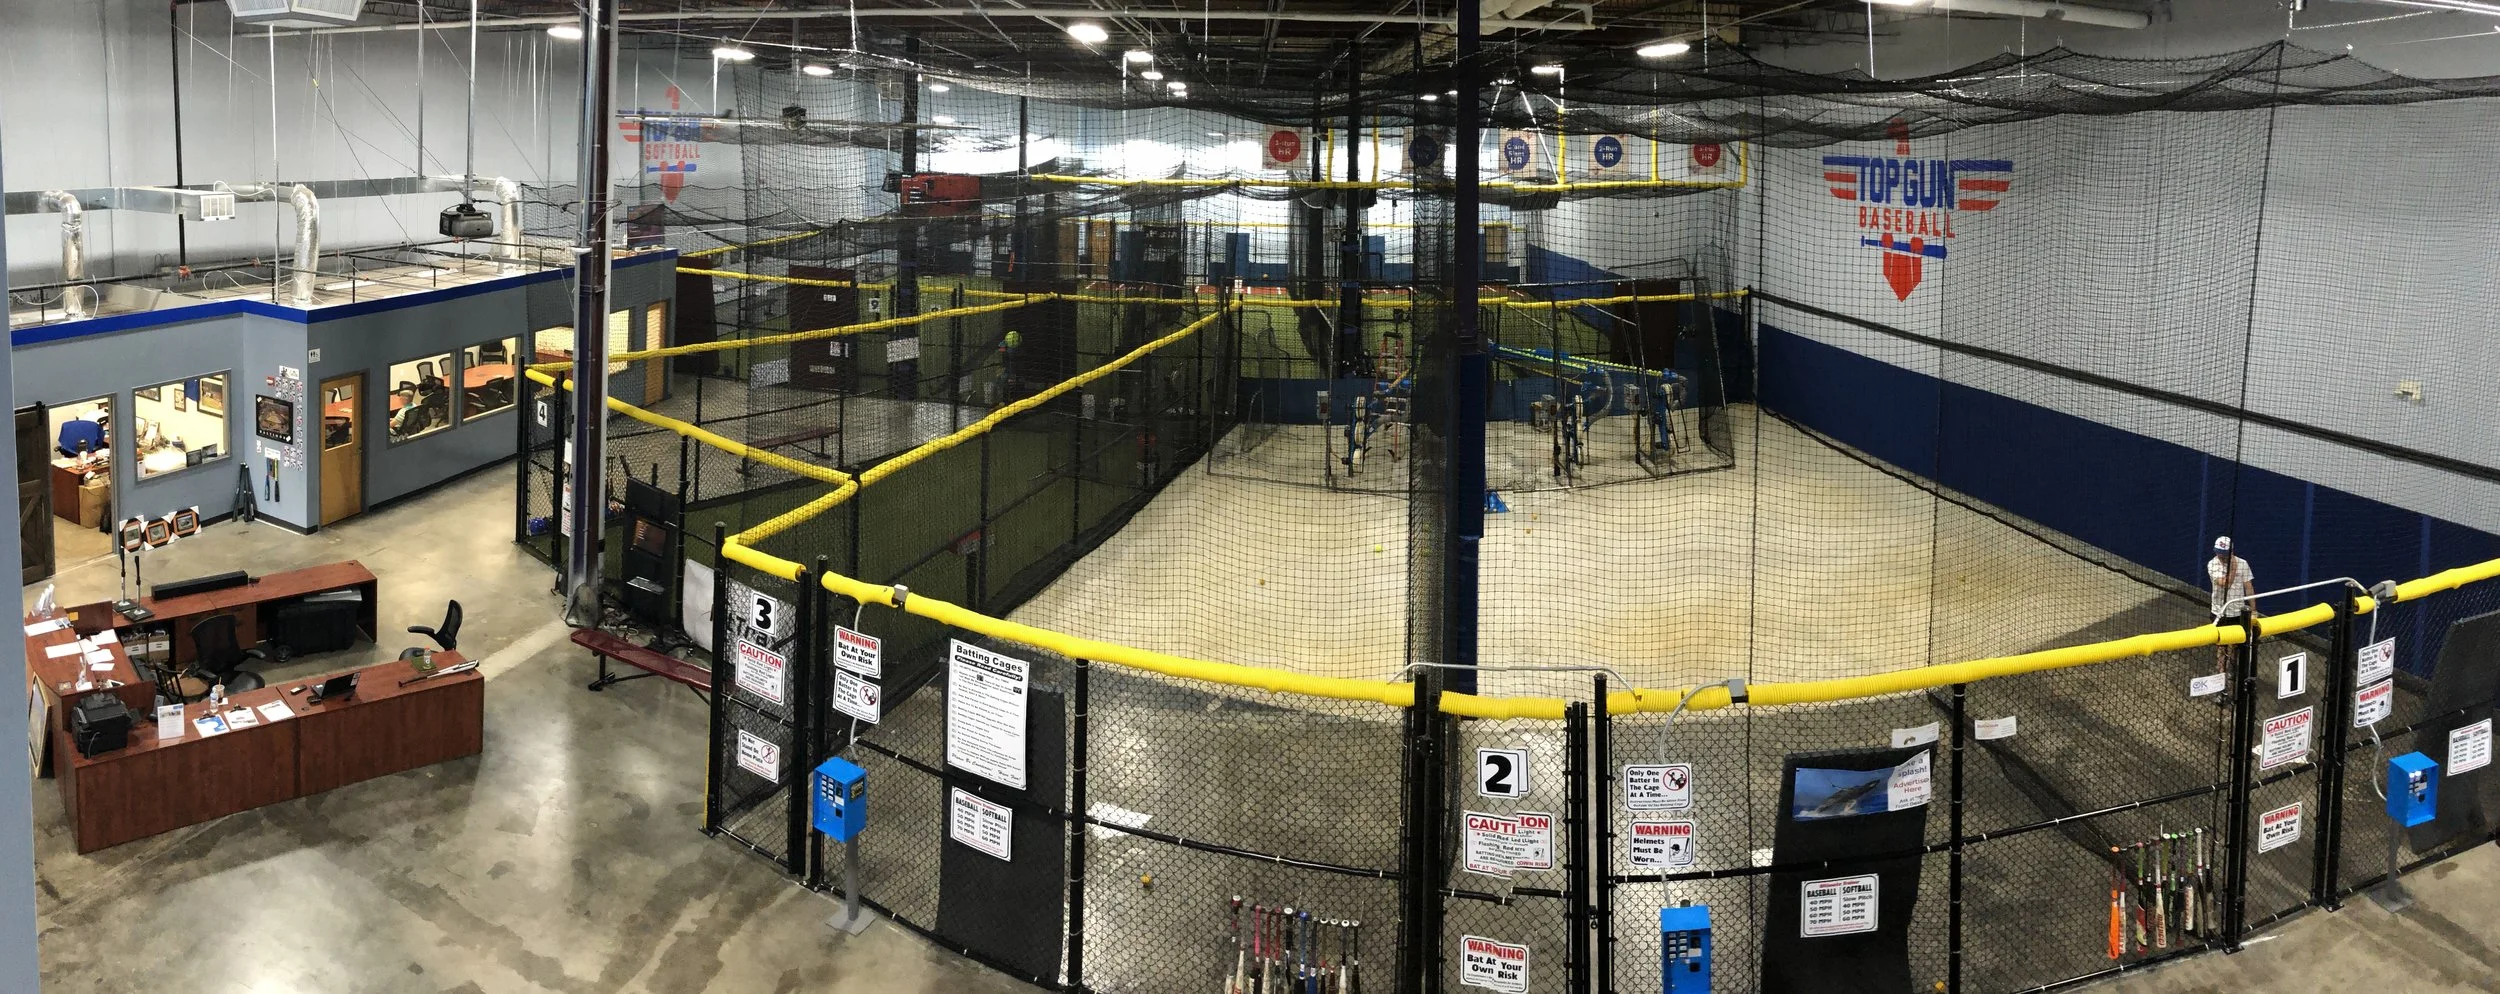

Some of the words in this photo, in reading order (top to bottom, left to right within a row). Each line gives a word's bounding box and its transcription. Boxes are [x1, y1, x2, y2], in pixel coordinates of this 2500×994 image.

[645, 144, 700, 160] SOFTBALL
[1278, 148, 1293, 156] HR
[1701, 153, 1714, 161] HR
[1859, 206, 1955, 238] BASEBALL
[539, 405, 545, 420] 4
[756, 598, 771, 629] 3
[839, 630, 877, 650] WARNING
[741, 643, 782, 668] CAUTION
[838, 642, 849, 651] Bat
[851, 646, 858, 654] At
[860, 649, 876, 659] Your
[841, 650, 857, 660] Own
[858, 656, 873, 666] Risk
[956, 645, 990, 664] Batting
[993, 657, 1023, 673] Cages
[977, 662, 992, 671] Read
[839, 675, 848, 684] Only
[2287, 659, 2299, 691] 1
[838, 687, 846, 695] The
[2360, 684, 2390, 701] WARNING
[2267, 711, 2310, 733] CAUTION
[1485, 755, 1512, 793] 2
[1893, 777, 1930, 789] Advertise
[956, 797, 978, 812] BASEBALL
[982, 808, 1007, 823] SOFTBALL
[2265, 806, 2299, 824] WARNING
[1635, 825, 1690, 835] WARNING
[2264, 826, 2274, 834] Bat
[2266, 831, 2280, 840] Own
[2282, 826, 2294, 834] Risk
[1807, 888, 1837, 898] BASEBALL
[1842, 884, 1872, 894] SOFTBALL
[1467, 940, 1524, 960] WARNING
[1467, 954, 1483, 963] Bat
[1486, 957, 1496, 965] At
[1501, 962, 1522, 971] Your
[1472, 964, 1493, 974] Own
[1498, 971, 1518, 980] Risk
